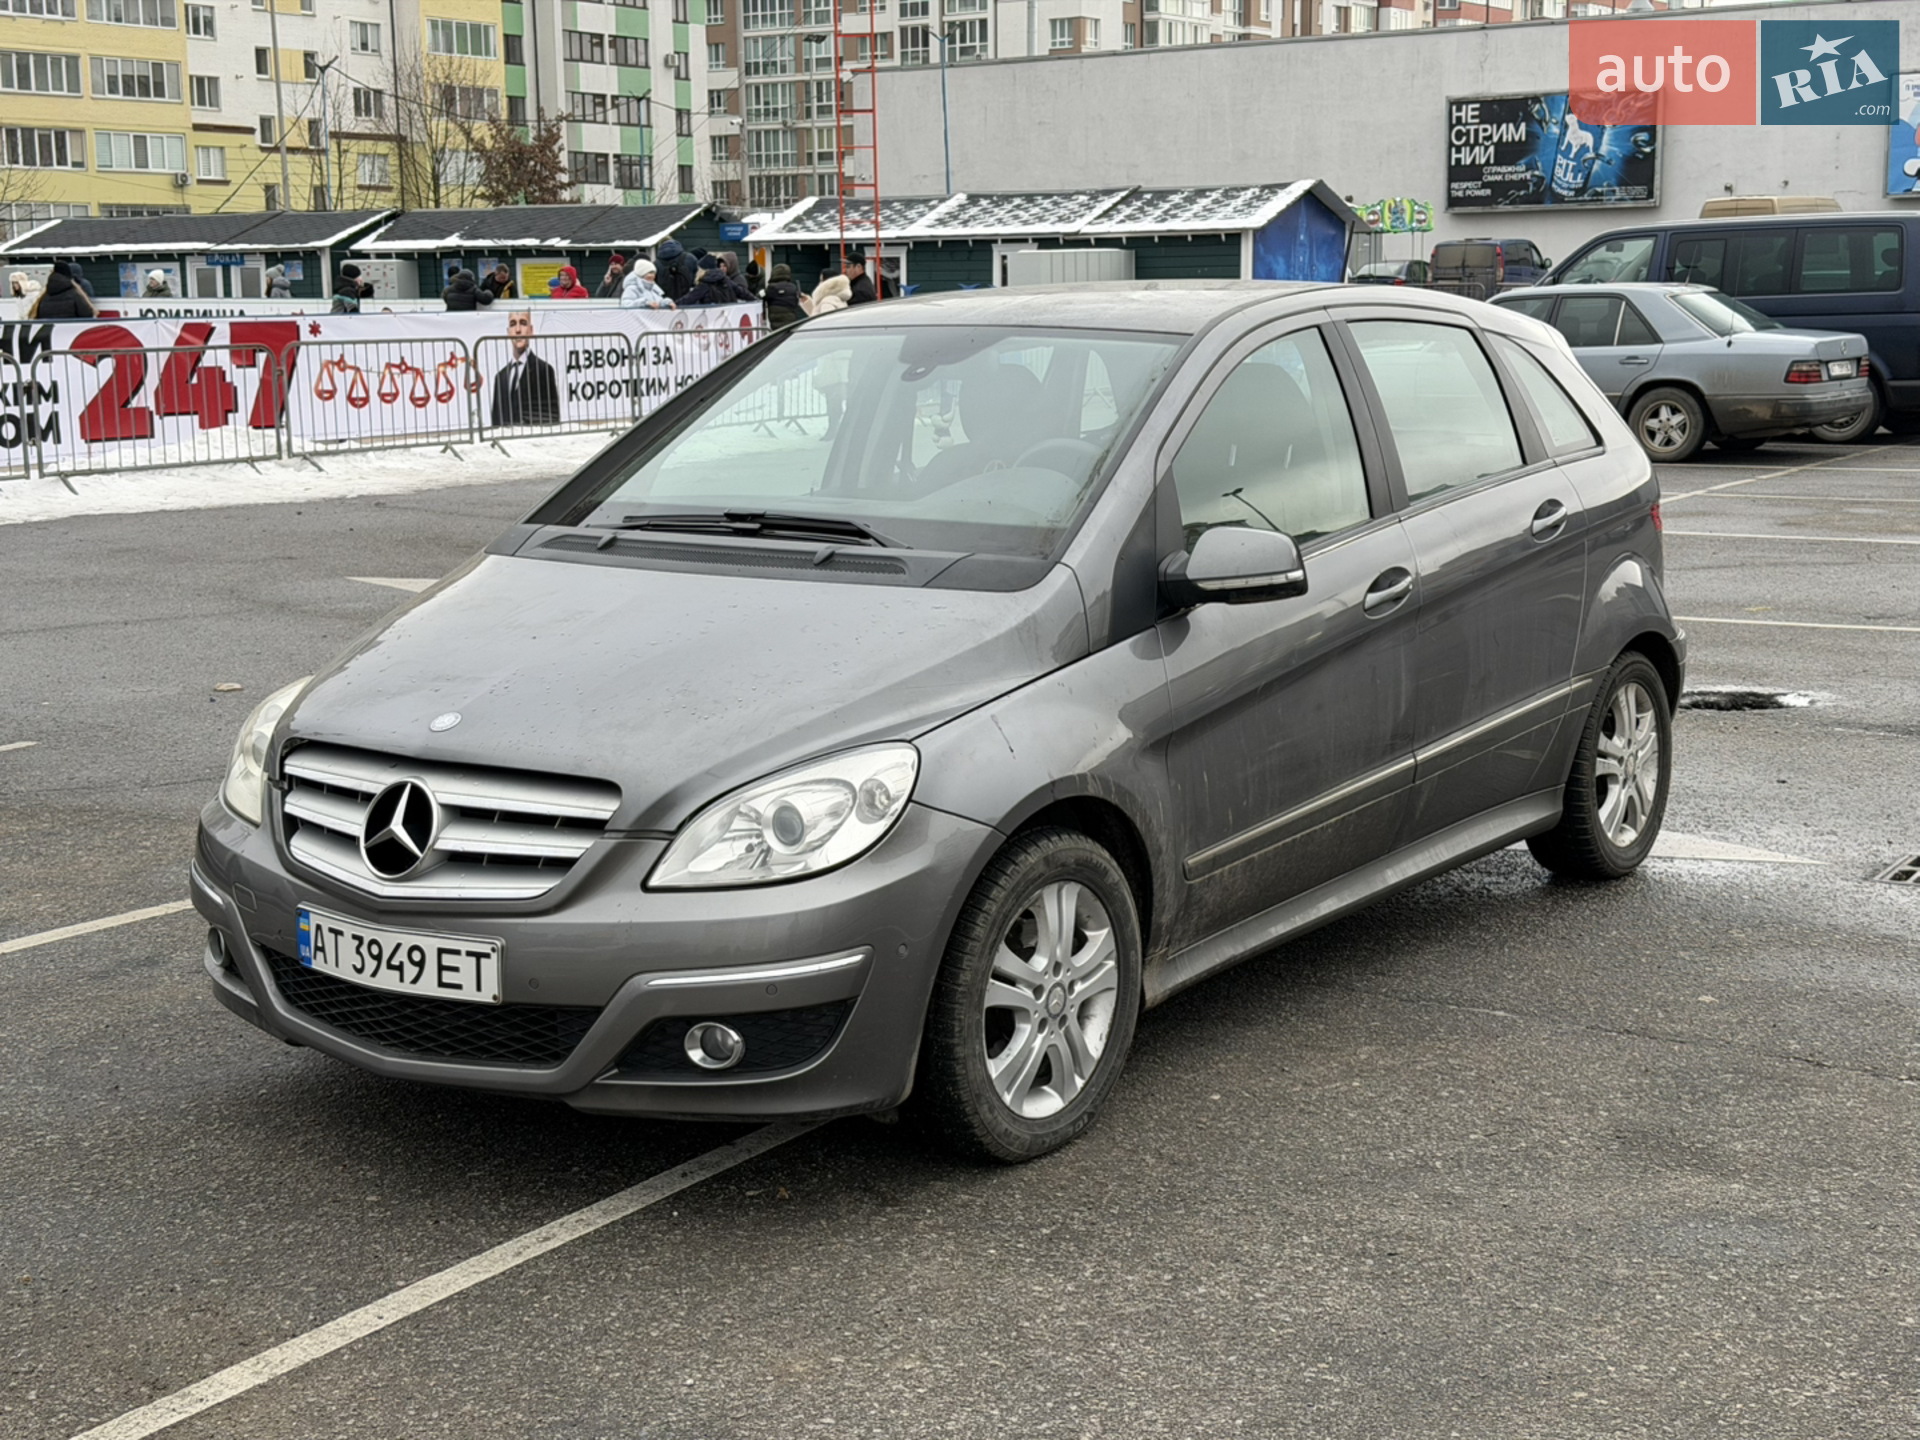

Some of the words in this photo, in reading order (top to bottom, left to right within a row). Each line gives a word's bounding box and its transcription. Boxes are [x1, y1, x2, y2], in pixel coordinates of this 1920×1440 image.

[1452, 103, 1480, 125] НЕ
[1451, 122, 1526, 146] СТРИМ
[1451, 140, 1495, 166] НИЙ
[1556, 154, 1577, 172] PIT
[1482, 173, 1503, 182] СМАК
[1554, 164, 1585, 183] BULL
[1450, 181, 1482, 190] RESPECT
[1451, 190, 1464, 198] THE
[1465, 188, 1492, 197] POWER
[566, 347, 647, 374] ДЗВОНИ
[652, 346, 674, 366] ЗА
[568, 376, 670, 402] КОРОТКИМ
[313, 923, 344, 968] AT
[351, 933, 426, 985] 3949
[437, 947, 491, 993] ET
